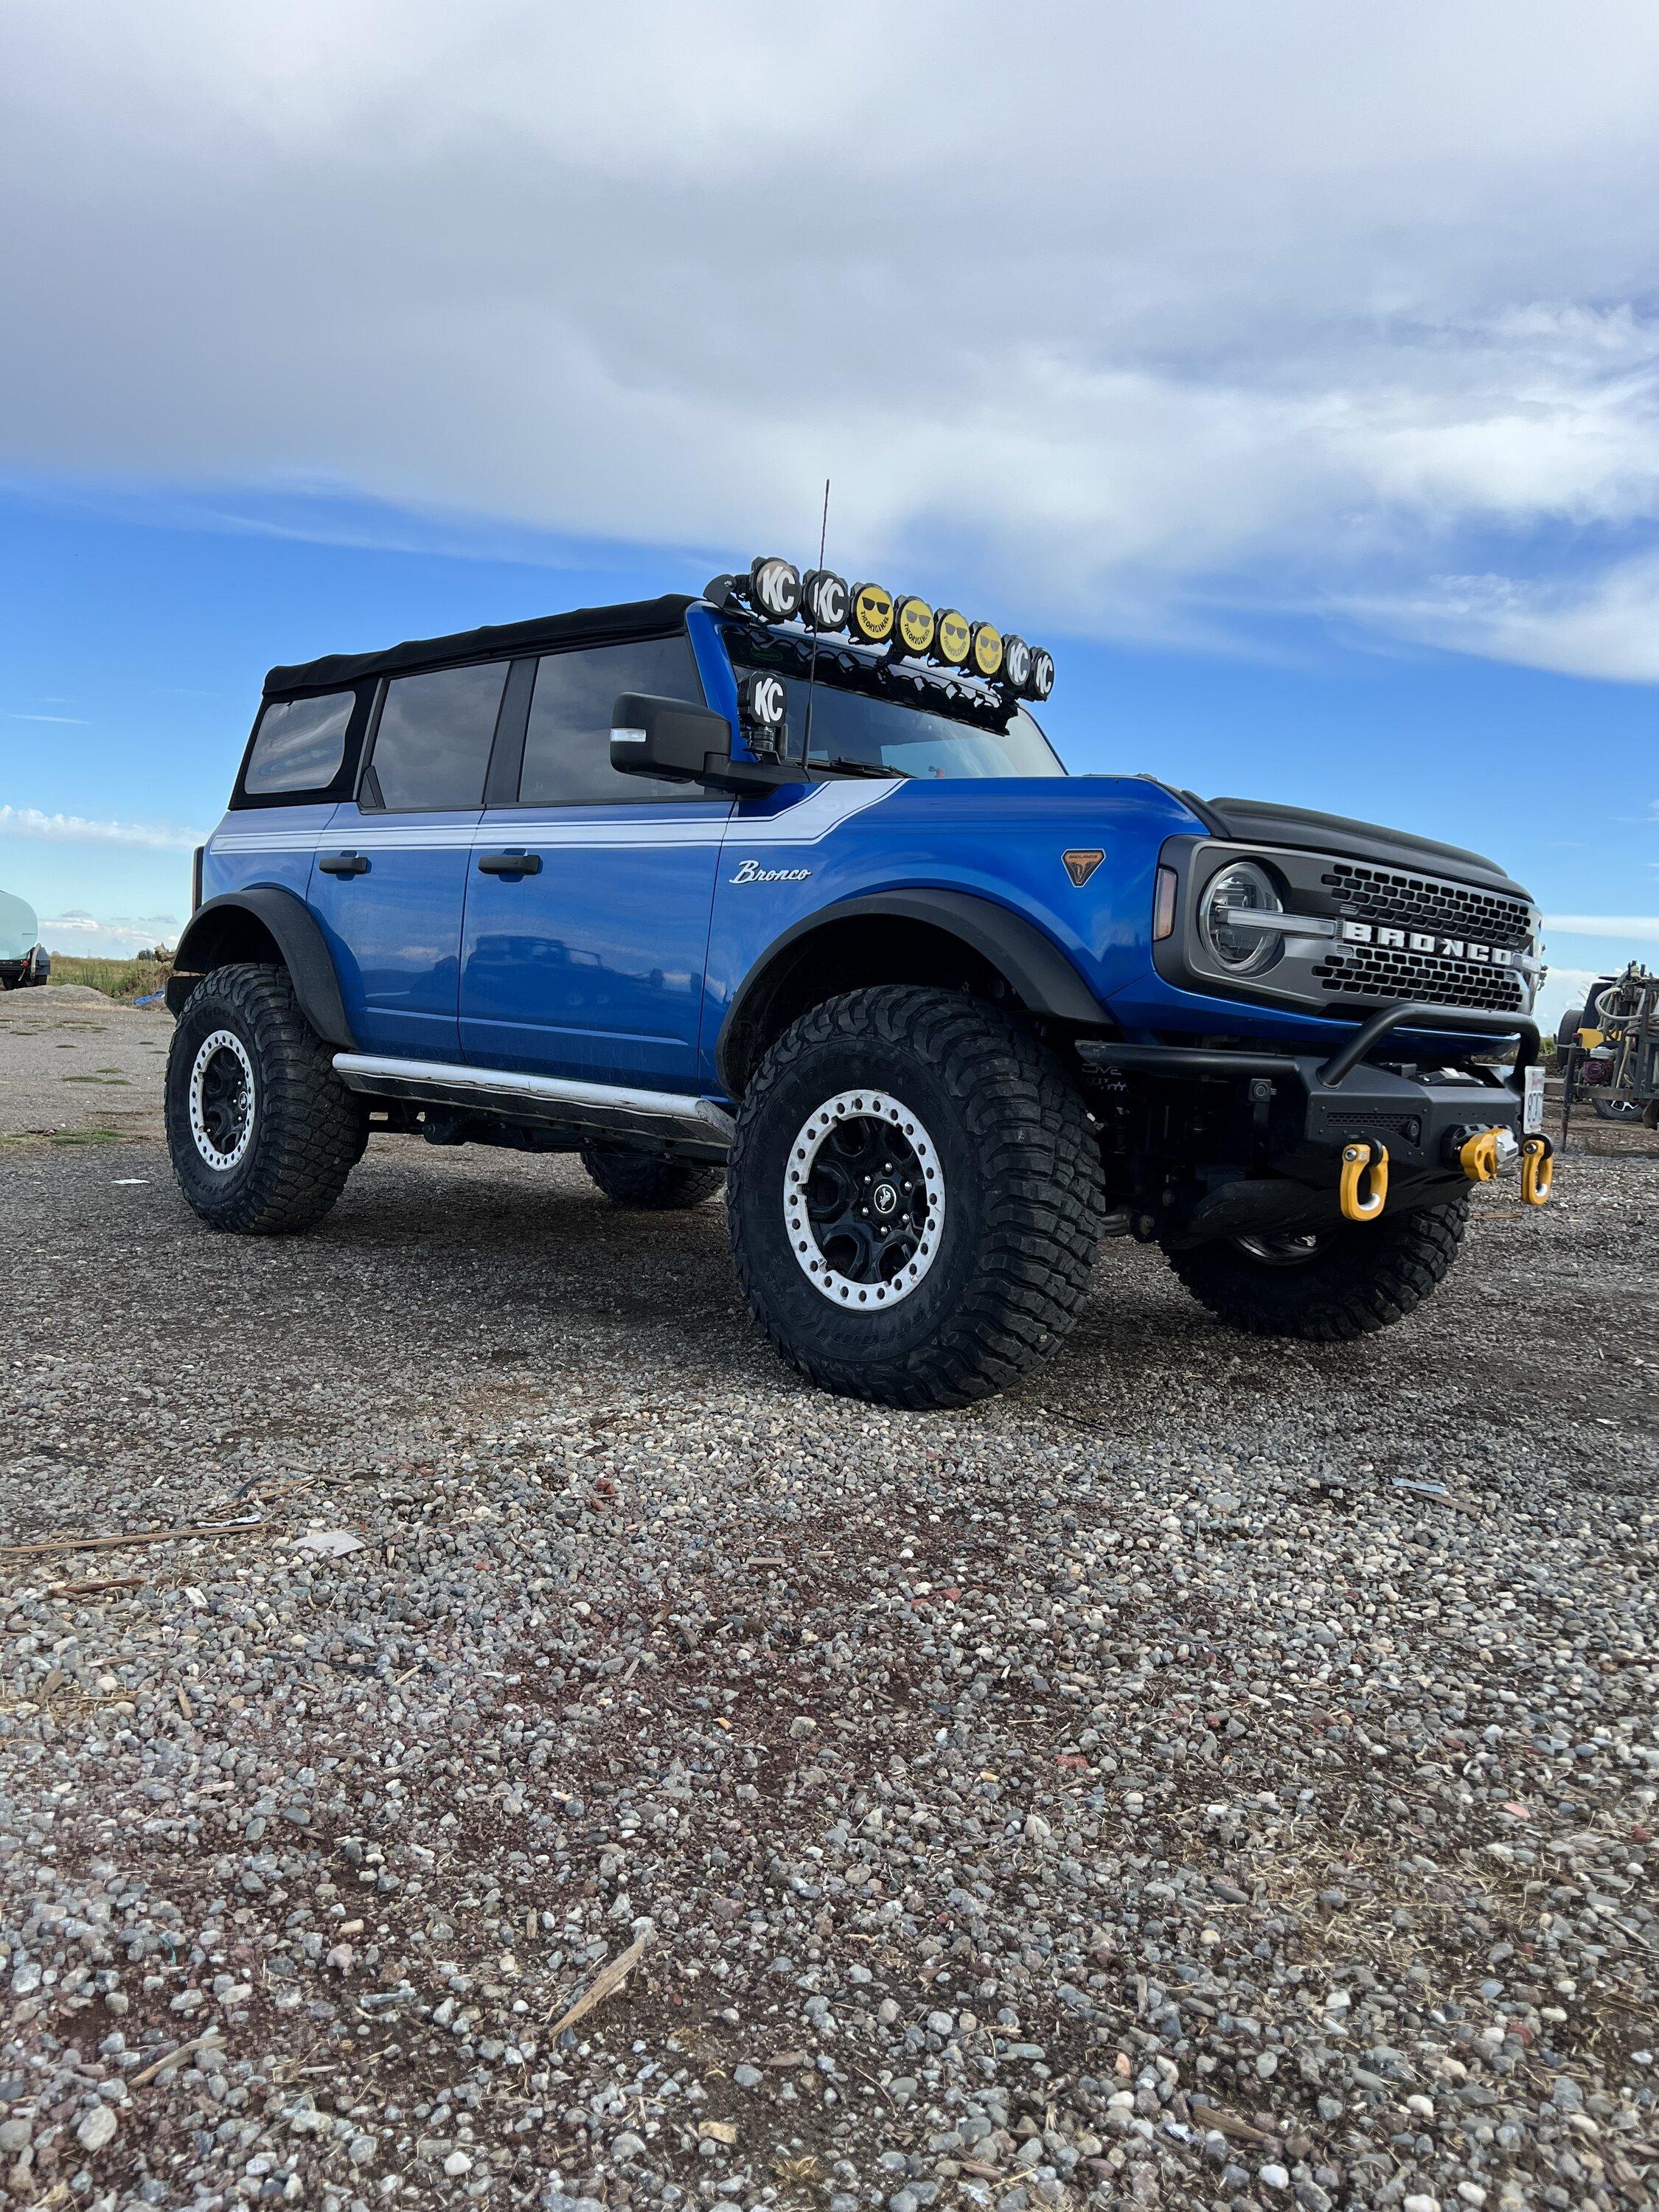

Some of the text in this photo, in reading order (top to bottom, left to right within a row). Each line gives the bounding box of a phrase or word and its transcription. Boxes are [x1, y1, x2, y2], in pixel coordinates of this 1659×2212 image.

[762, 566, 796, 612] KC
[813, 578, 844, 624] KC
[1009, 642, 1029, 683] KC
[1035, 655, 1053, 695] KC
[754, 677, 784, 723] KC
[728, 860, 812, 884] Bronco
[1342, 921, 1512, 966] BRONCO
